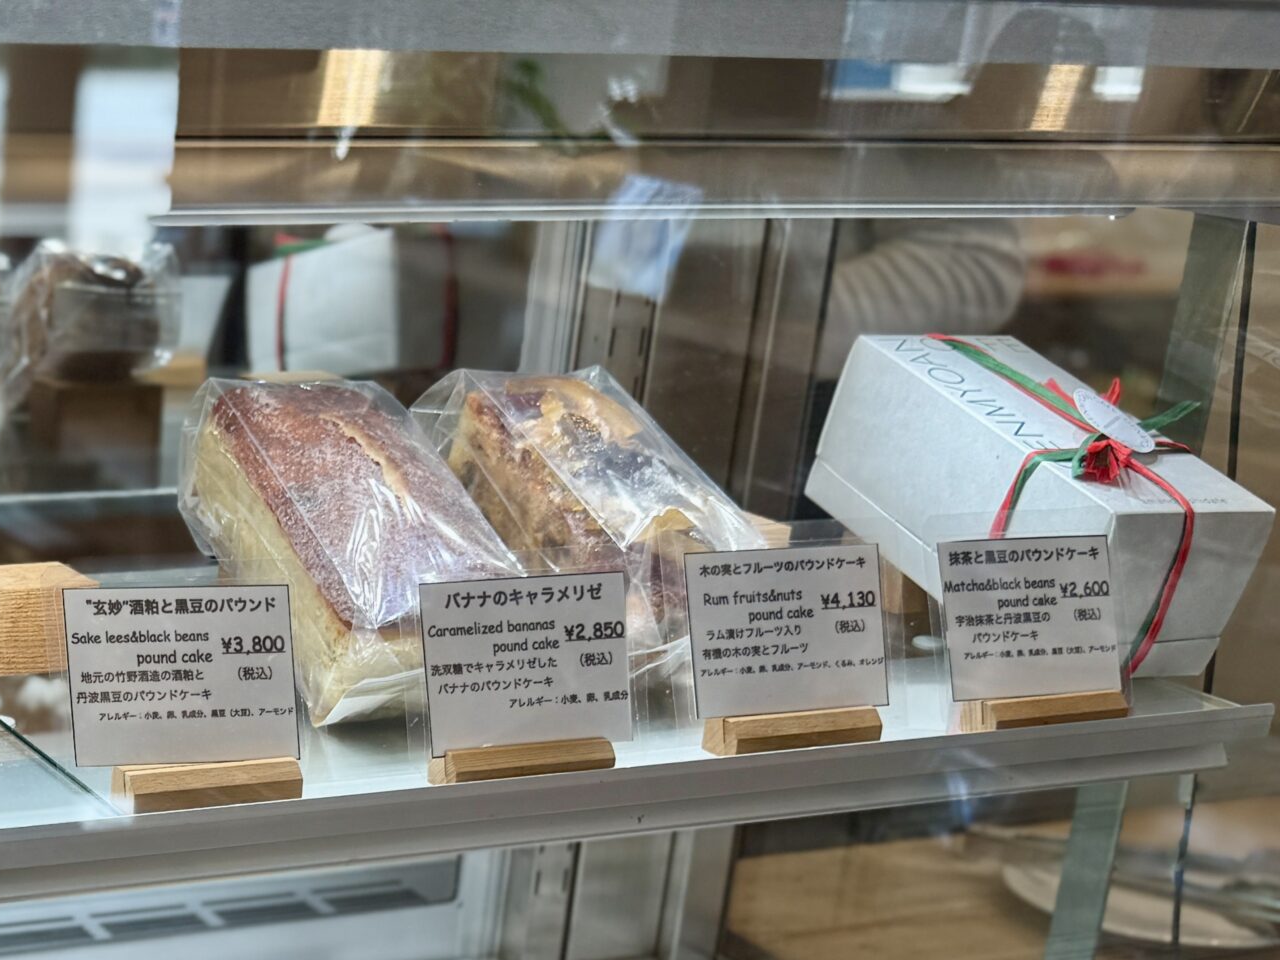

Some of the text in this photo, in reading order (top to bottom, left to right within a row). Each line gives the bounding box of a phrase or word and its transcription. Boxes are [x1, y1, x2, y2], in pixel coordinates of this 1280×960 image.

[878, 337, 1062, 452] ENMYOAN
[949, 546, 1099, 566] 抹茶と黒豆のパウンドケーキ
[700, 557, 866, 577] 木の実とフルーツのパウンドケーキ
[944, 578, 1055, 593] Matcha&black beans
[1060, 581, 1109, 598] ¥2,600
[445, 583, 602, 609] バナナのキャラメリゼ
[704, 590, 802, 606] Rum fruits&nuts
[821, 590, 875, 609] ¥4,130
[998, 596, 1057, 609] pound cake
[749, 607, 814, 623] pound cake
[956, 612, 1050, 627] 宇治抹茶と丹波黒豆の
[428, 619, 555, 637] Caramelized bananas
[564, 621, 624, 641] ¥2,850
[707, 625, 801, 640] ラム漬けフルーツ入り
[835, 620, 865, 634] （税込）
[71, 630, 209, 644] Sake lees&black beans
[973, 631, 1038, 643] パウンドケーキ
[222, 636, 285, 655] ¥3,800
[493, 639, 559, 655] pound cake
[702, 643, 808, 660] 有機の木の実とフルーツ
[137, 651, 213, 666] pound cake
[431, 657, 557, 676] 洗双糖でキャラメリゼした
[580, 652, 612, 667] （税込）
[81, 672, 204, 683] 地元の竹野酒造の酒粕と
[238, 667, 272, 680] （税込）
[439, 676, 553, 694] バナナのパウンドケーキ
[77, 689, 211, 703] 丹波黒豆のパウンドケーキ
